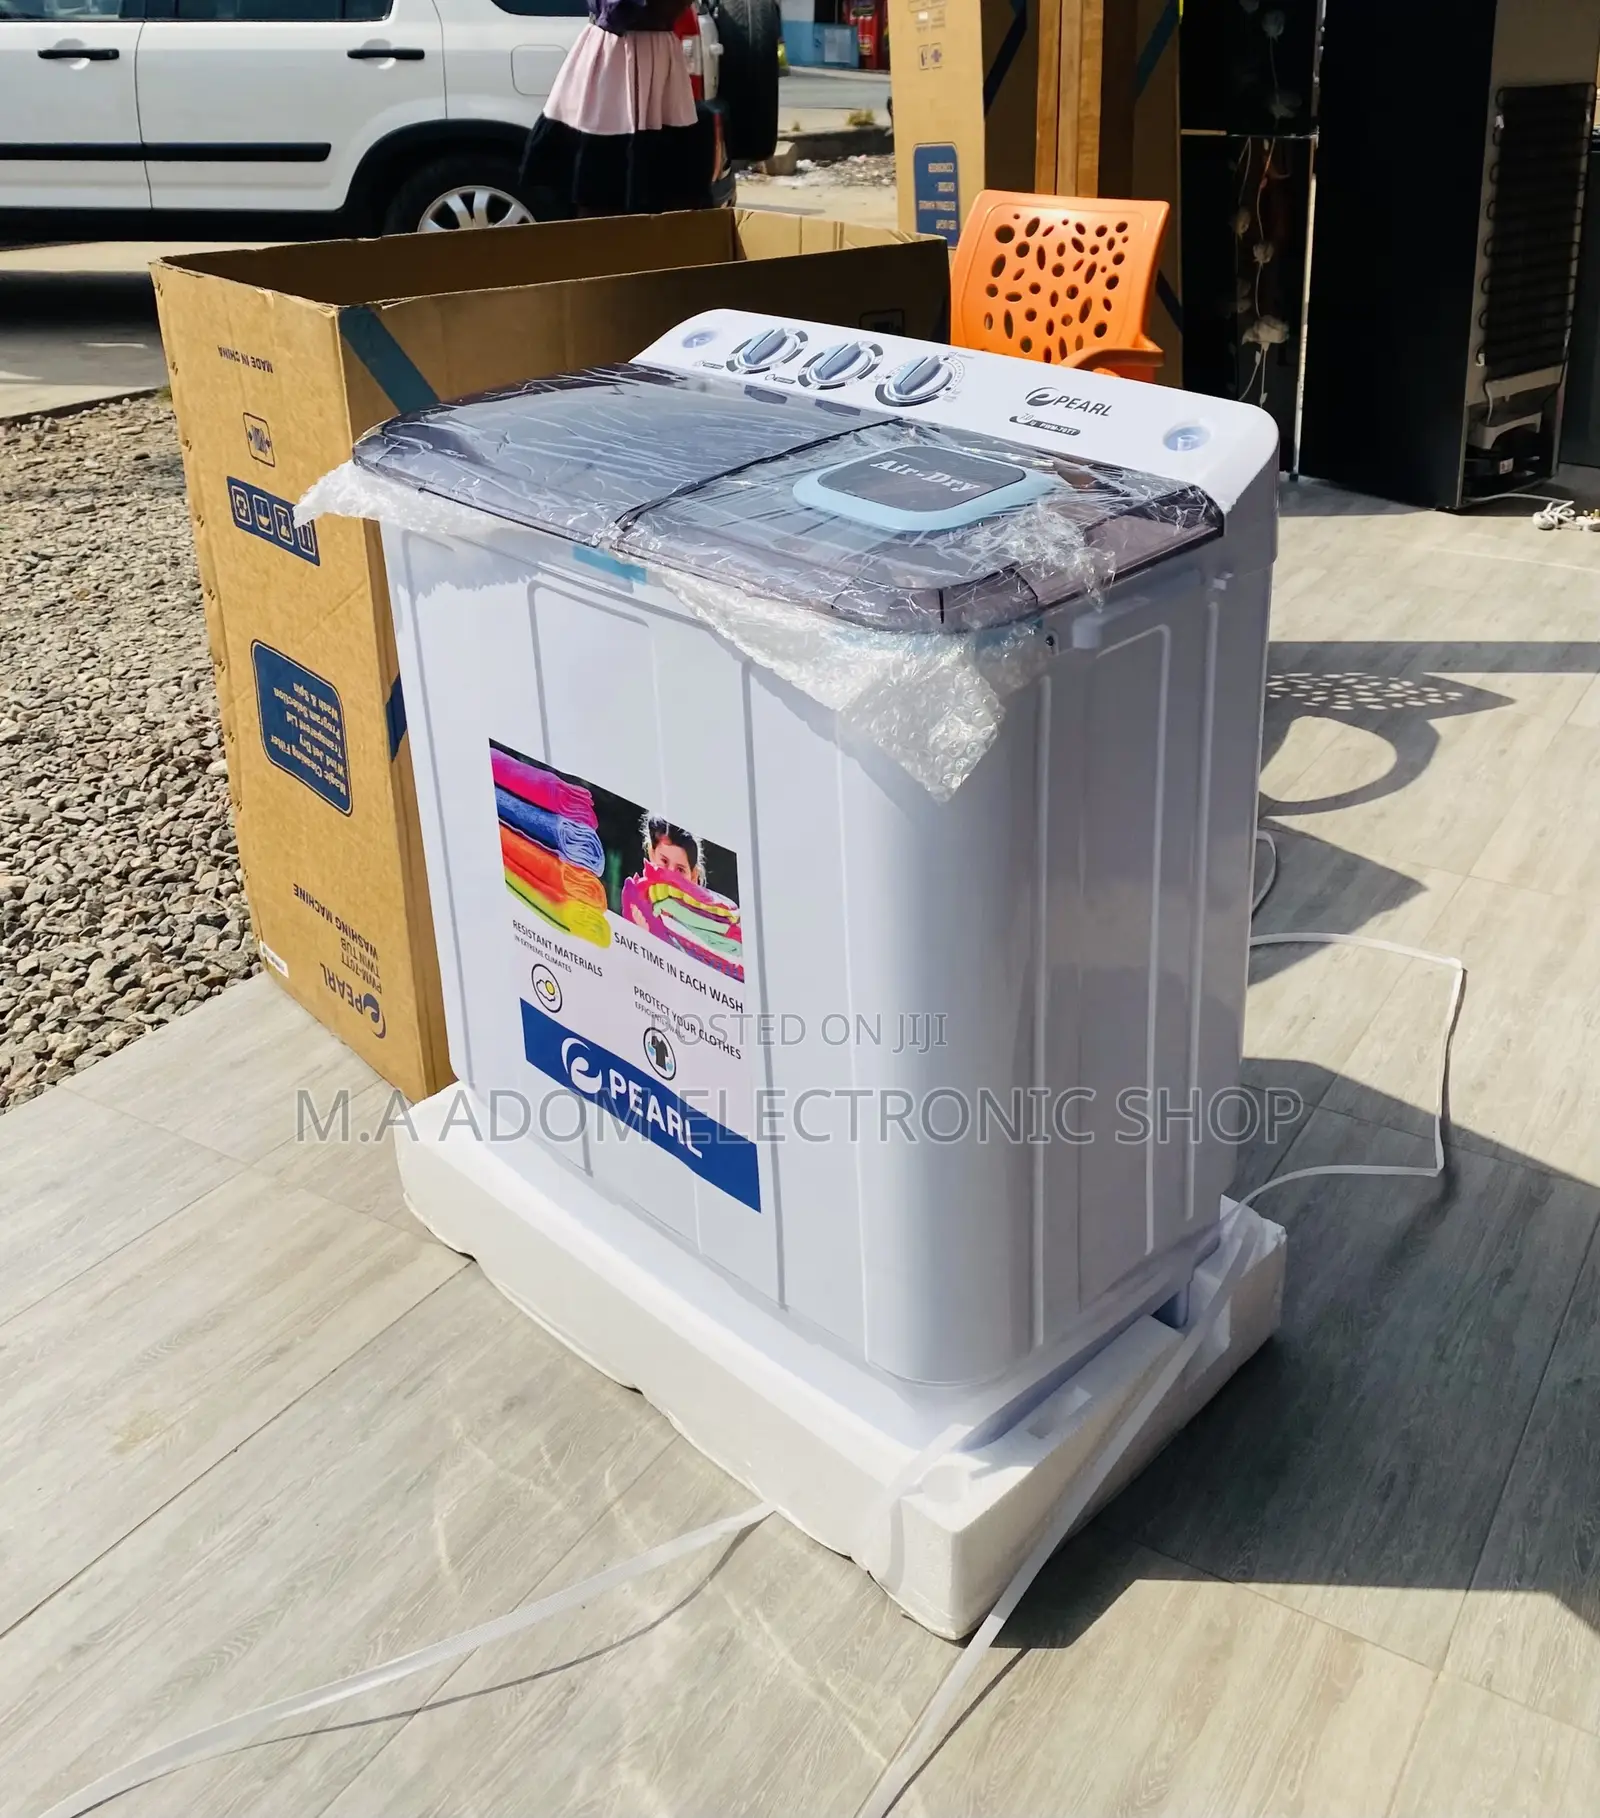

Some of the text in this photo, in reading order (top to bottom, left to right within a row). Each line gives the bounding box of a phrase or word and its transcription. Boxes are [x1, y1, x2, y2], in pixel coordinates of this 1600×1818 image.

[217, 345, 274, 374] MADE IN CHINA
[1053, 395, 1113, 417] PEARL
[869, 460, 980, 492] Air-Dry
[273, 687, 341, 741] Program Selection
[293, 682, 339, 722] Wash & Spin
[299, 718, 343, 760] Transparent
[300, 734, 312, 754] Dry
[271, 734, 346, 796] Magic Cleaning Filter
[325, 755, 345, 778] Wind
[293, 883, 333, 924] MACHINE
[335, 917, 378, 960] WASHING
[340, 937, 381, 979] TWIN TUB
[512, 919, 603, 977] RESISTANT MATERIALS
[520, 938, 544, 958] EXTREME
[544, 952, 572, 973] CLIMATES
[320, 962, 363, 1015] PEARL
[614, 932, 743, 1014] SAVE TIME IN EACH WASH
[634, 986, 742, 1060] PROTECT YOUR CLOTHES
[609, 1068, 703, 1159] PEARL
